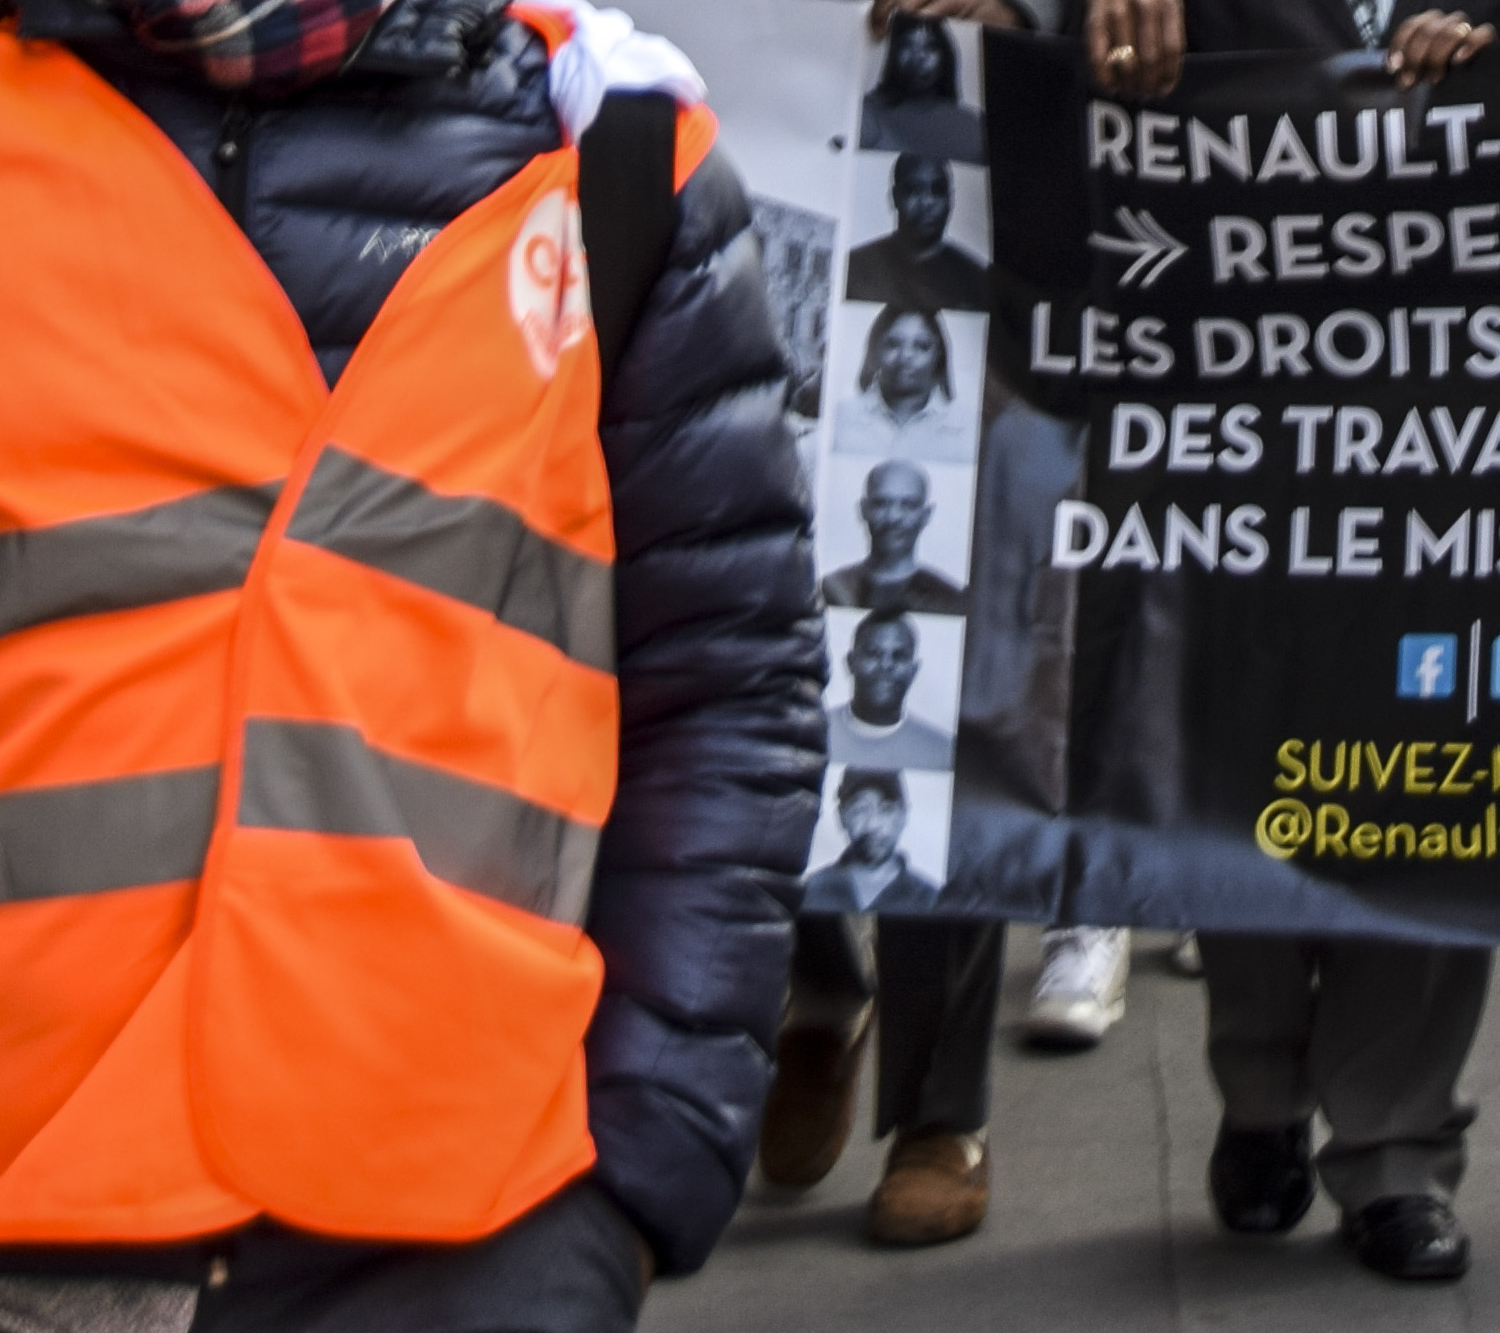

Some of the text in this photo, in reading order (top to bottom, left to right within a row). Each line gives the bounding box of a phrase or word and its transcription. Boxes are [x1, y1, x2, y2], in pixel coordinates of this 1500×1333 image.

[1029, 299, 1175, 379] LES
[1107, 400, 1264, 473] DES
[1050, 498, 1271, 578] DANS
[1288, 503, 1384, 577] LE
